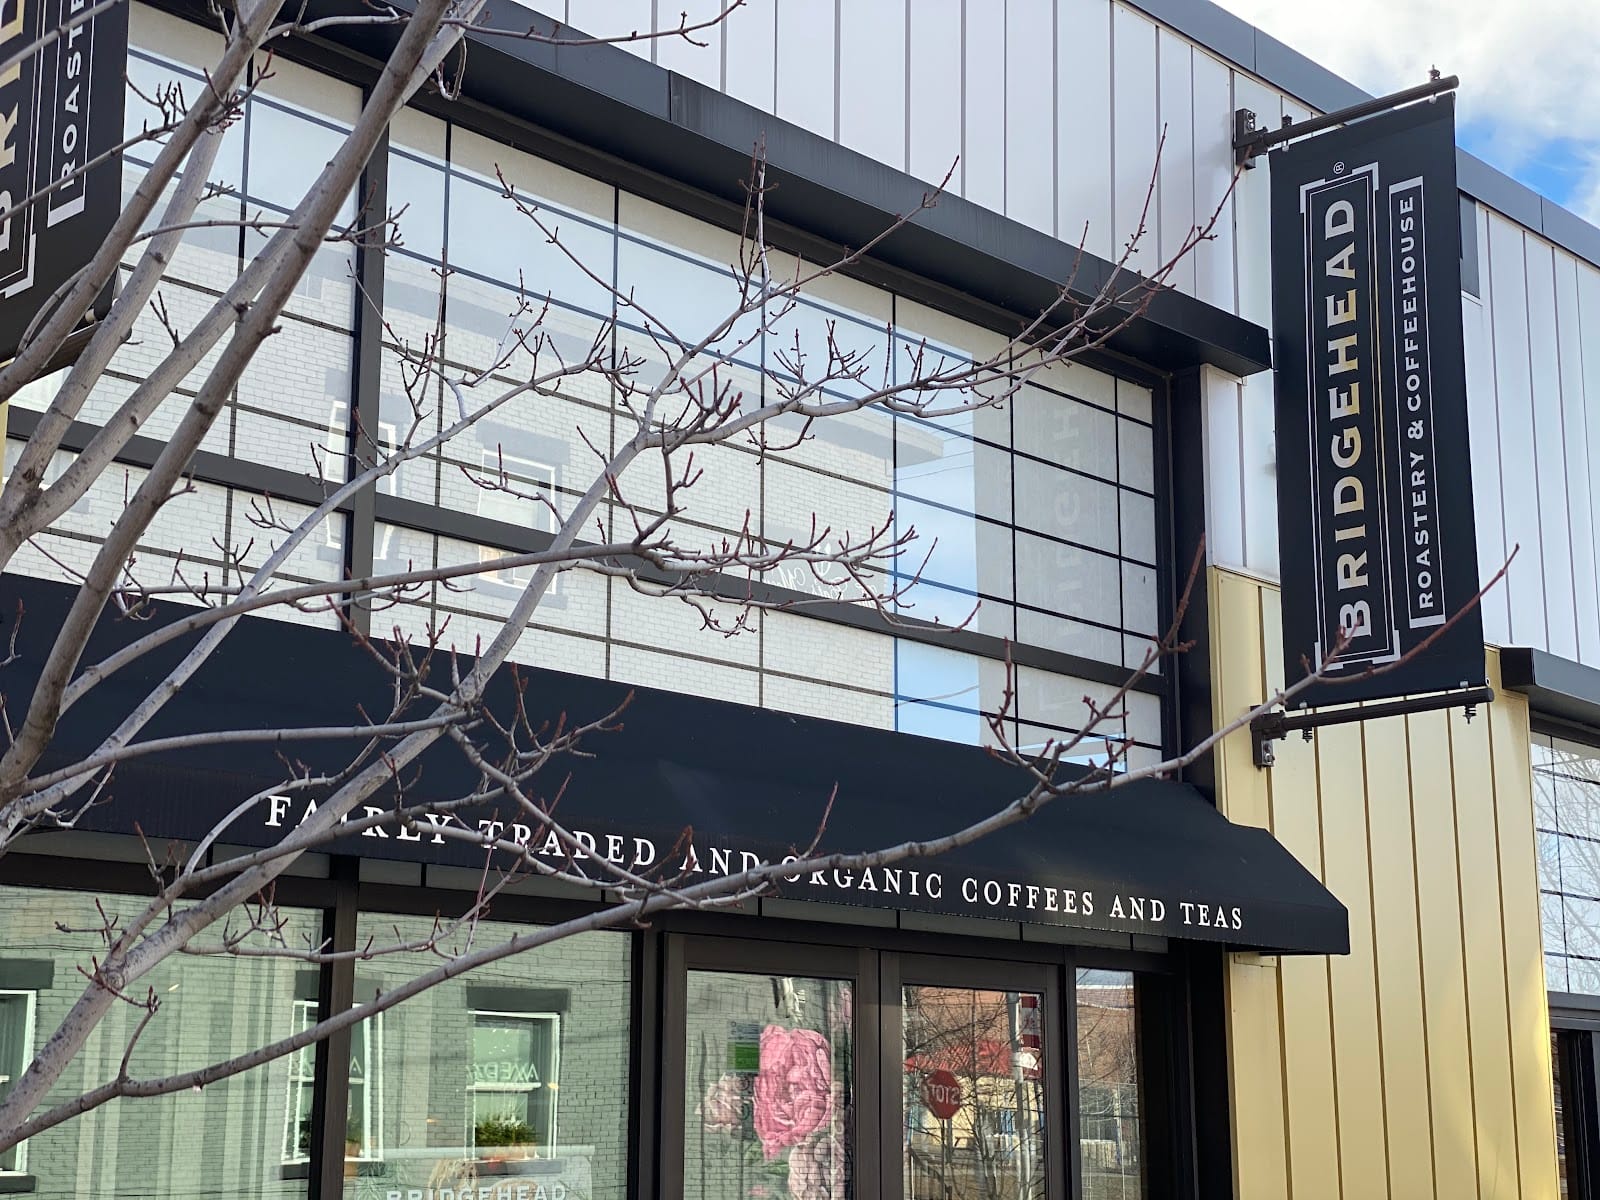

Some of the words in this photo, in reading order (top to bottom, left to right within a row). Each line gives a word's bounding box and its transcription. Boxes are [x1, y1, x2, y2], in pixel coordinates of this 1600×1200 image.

[1400, 197, 1421, 412] COFFEEHOUSE
[1325, 200, 1372, 639] BRIDGEHEAD
[1407, 420, 1424, 440] &
[1410, 452, 1434, 609] ROASTERY
[264, 795, 453, 844] FARLY
[478, 819, 656, 866] TRADED
[679, 844, 761, 876] AND
[962, 877, 1094, 916] COFFEES
[1109, 895, 1166, 922] AND
[1180, 902, 1242, 930] TEAS
